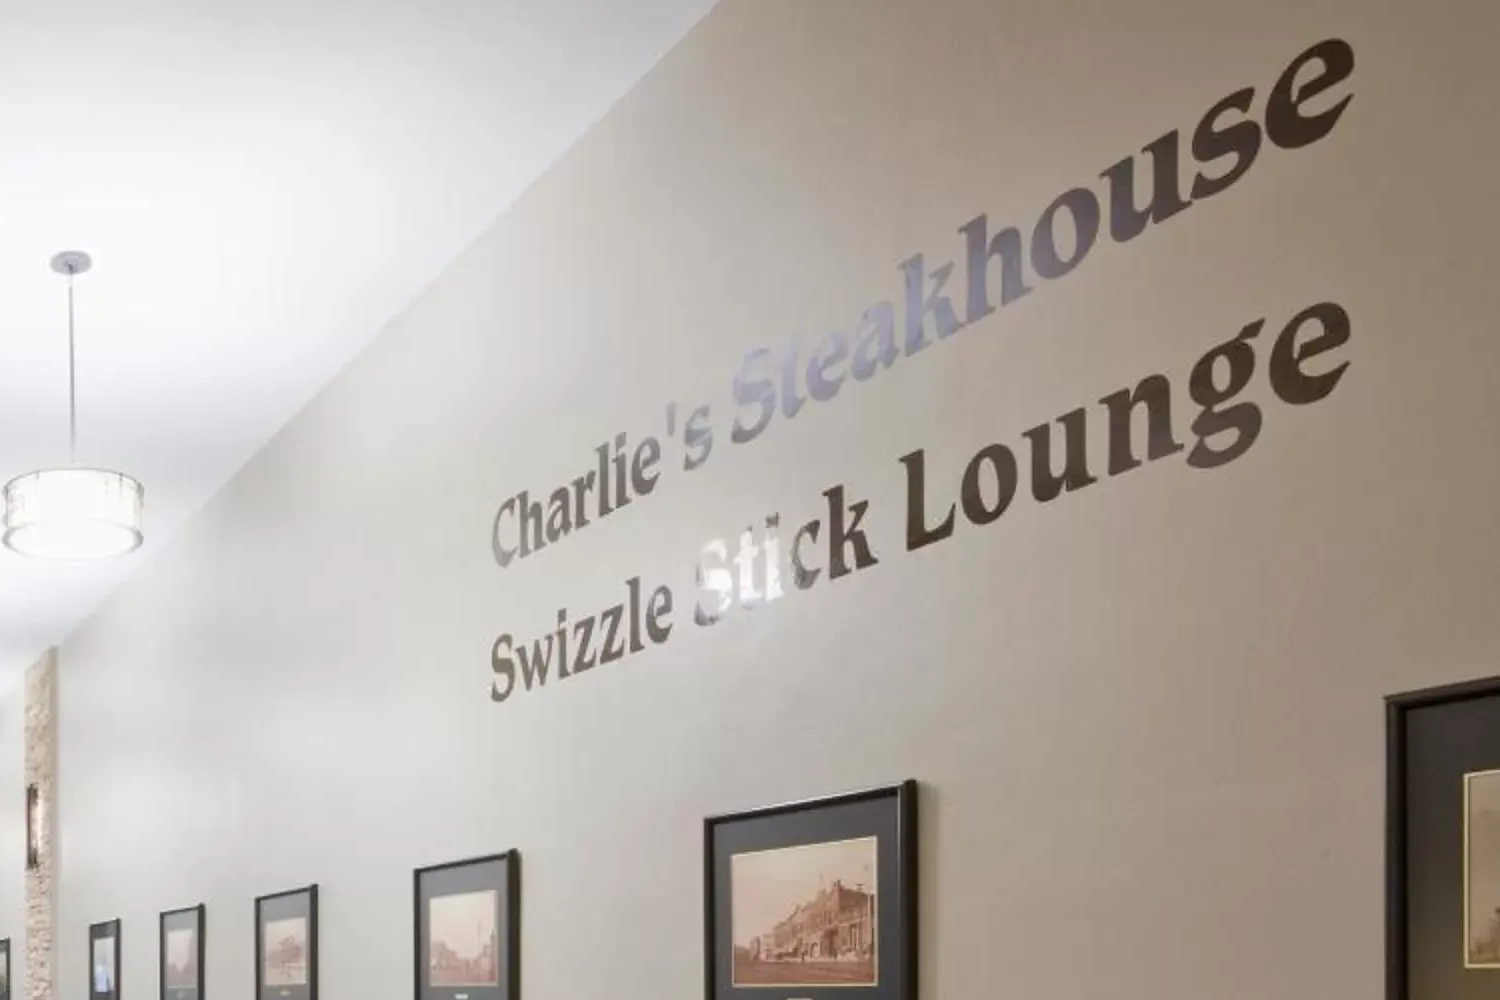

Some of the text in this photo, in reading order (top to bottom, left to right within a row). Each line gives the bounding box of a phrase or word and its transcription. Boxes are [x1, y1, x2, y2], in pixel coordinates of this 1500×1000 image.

[490, 302, 1352, 702] Swizzle Stick Lounge
[492, 38, 1355, 568] Charlie's Steakhouse
